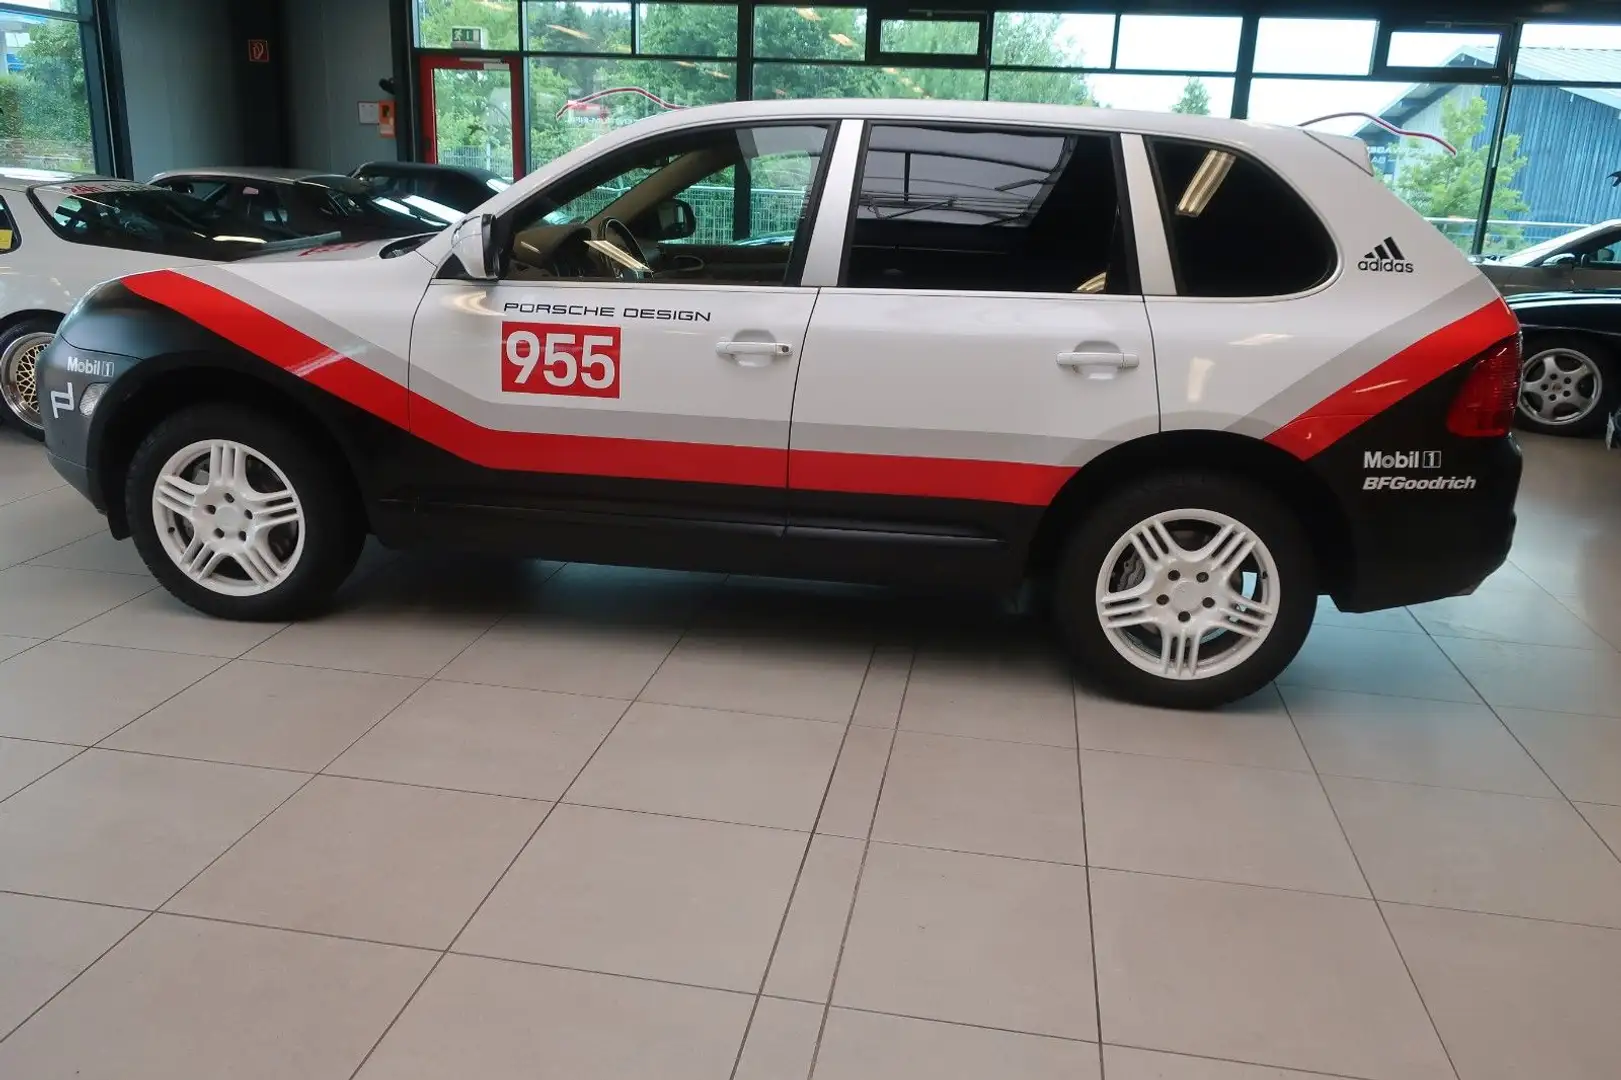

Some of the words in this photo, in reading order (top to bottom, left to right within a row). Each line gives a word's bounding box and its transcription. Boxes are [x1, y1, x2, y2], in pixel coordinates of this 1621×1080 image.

[1357, 259, 1415, 273] adidas
[503, 302, 616, 318] PORSCHE
[622, 307, 712, 322] DESIGN
[66, 355, 101, 375] Mobil
[505, 330, 616, 390] 955
[1363, 450, 1420, 469] Mobil
[1362, 475, 1477, 490] BFGoodrich
